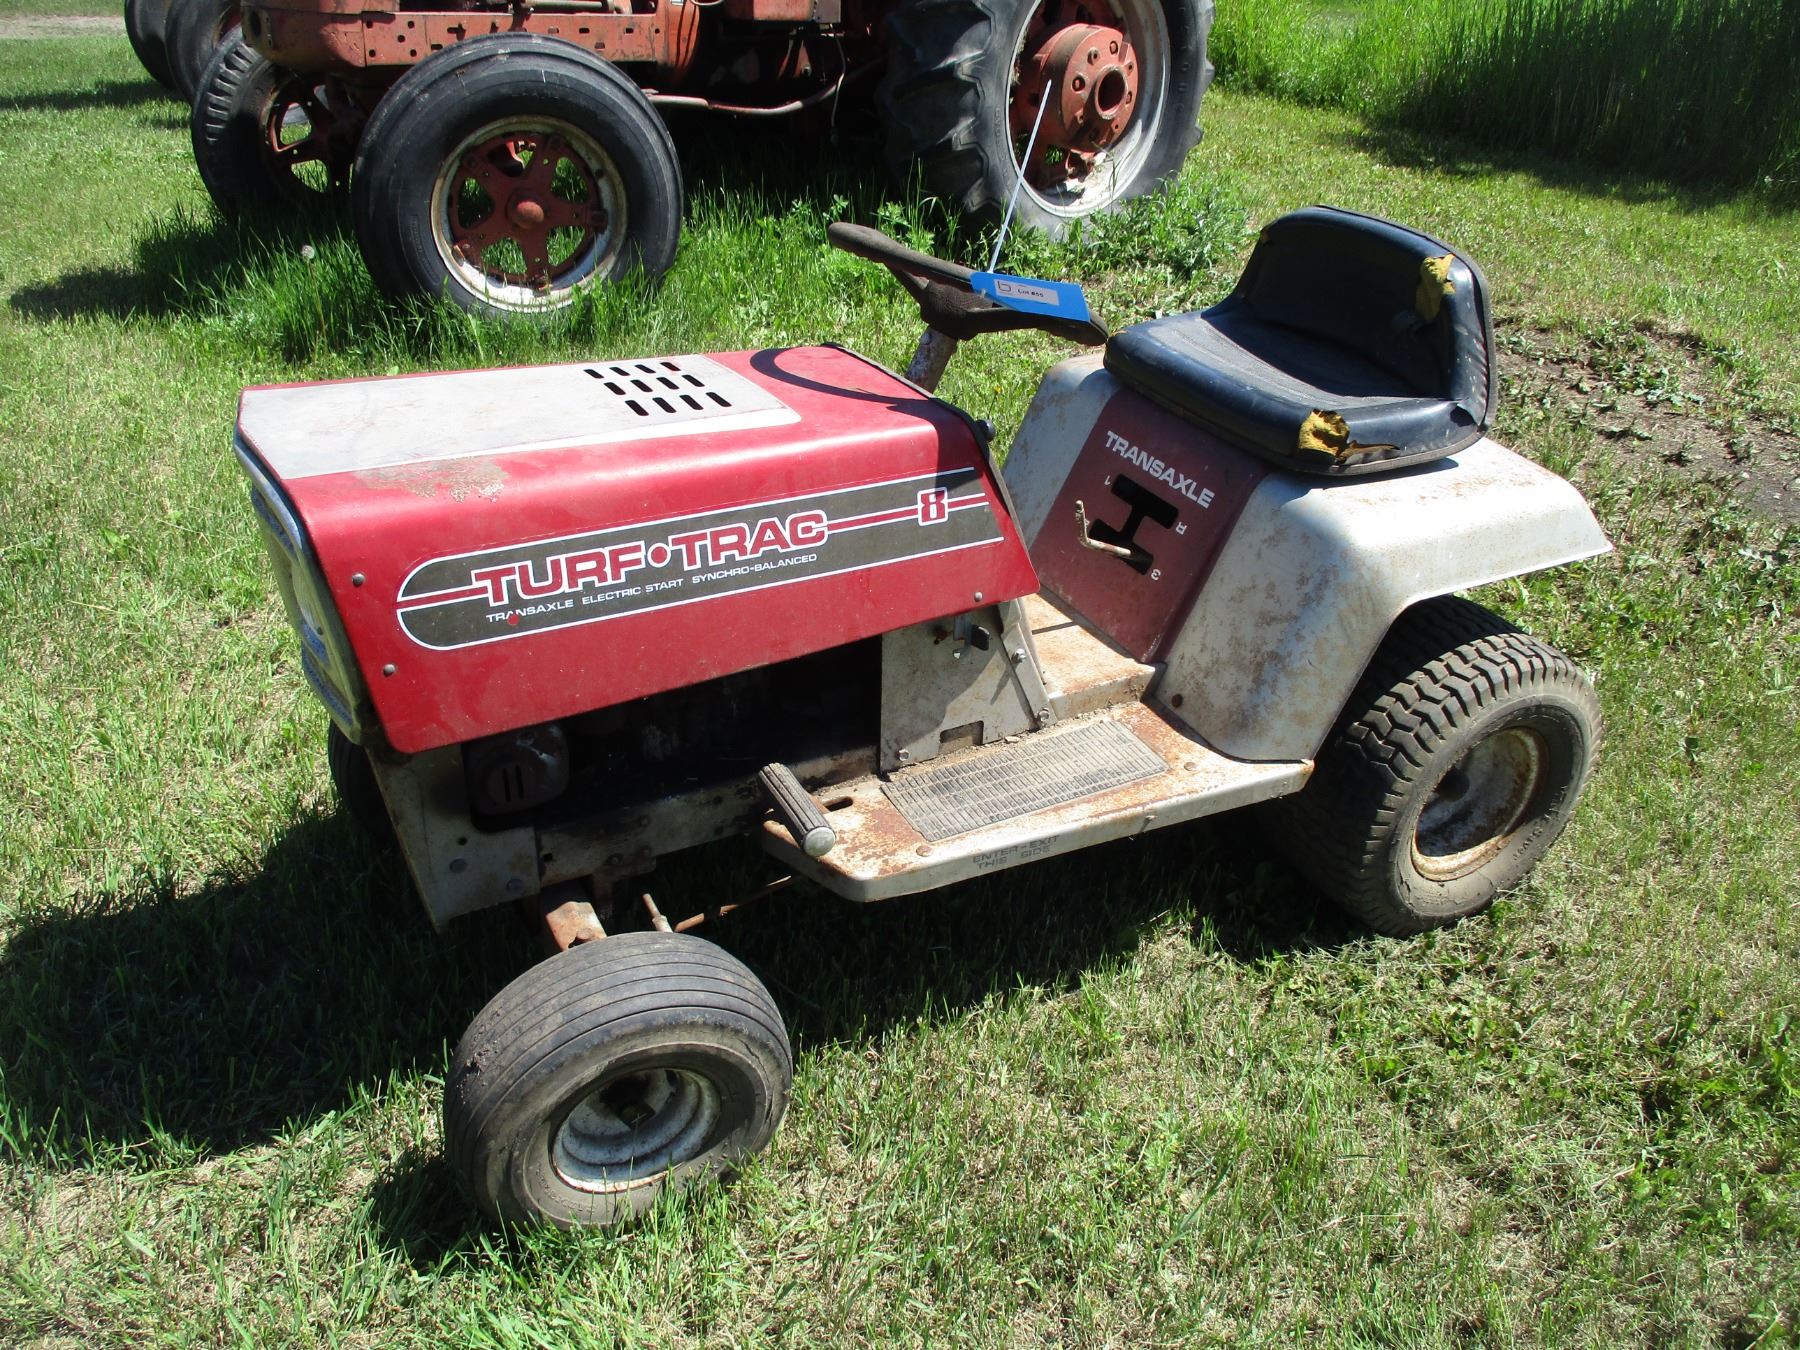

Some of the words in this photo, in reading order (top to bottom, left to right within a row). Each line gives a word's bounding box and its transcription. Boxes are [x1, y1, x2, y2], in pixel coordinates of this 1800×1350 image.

[1017, 288, 1030, 296] Lot
[1105, 430, 1216, 509] TRANSAXLE
[917, 487, 949, 526] 8
[1175, 521, 1188, 535] R
[582, 586, 642, 606] ELECTRIC
[645, 578, 685, 593] START
[692, 553, 818, 585] SYNCHRO-BALANCED
[1150, 568, 1162, 581] 3
[977, 856, 1008, 870] THIS
[1020, 845, 1051, 859] SIDE
